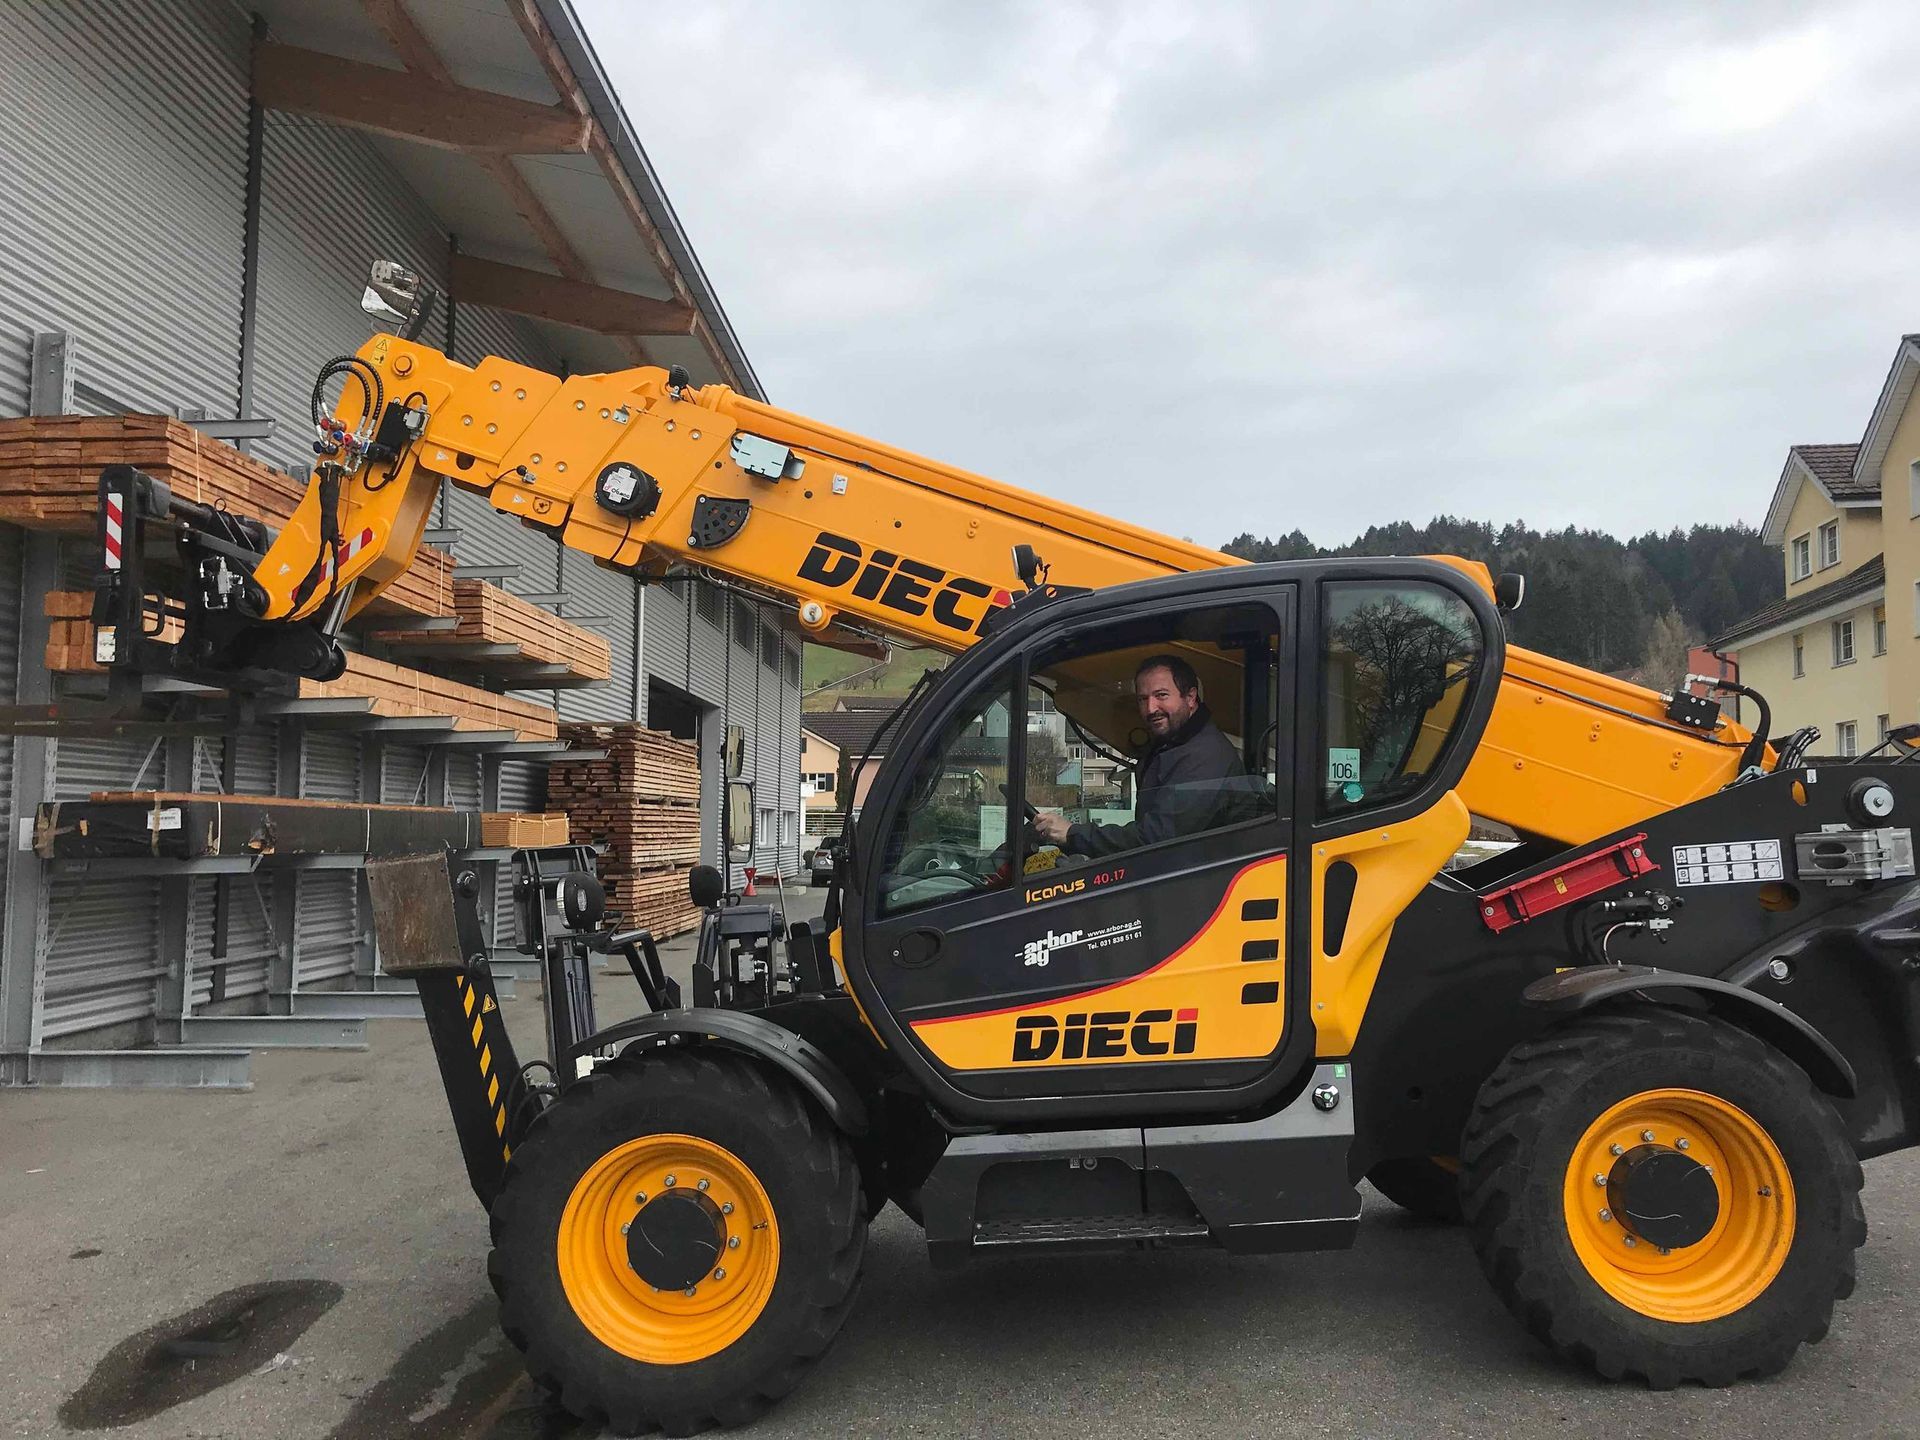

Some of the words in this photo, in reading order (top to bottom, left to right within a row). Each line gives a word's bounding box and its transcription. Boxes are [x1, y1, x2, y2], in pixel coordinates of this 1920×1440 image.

[1332, 763, 1352, 779] 106
[1093, 868, 1126, 886] 40.17
[1087, 919, 1142, 937] www.arbor-ag.ch
[1024, 930, 1083, 954] arbor
[1087, 942, 1099, 950] Tel.
[1099, 939, 1111, 947] 031
[1125, 933, 1133, 941] 51
[1024, 948, 1050, 967] ag
